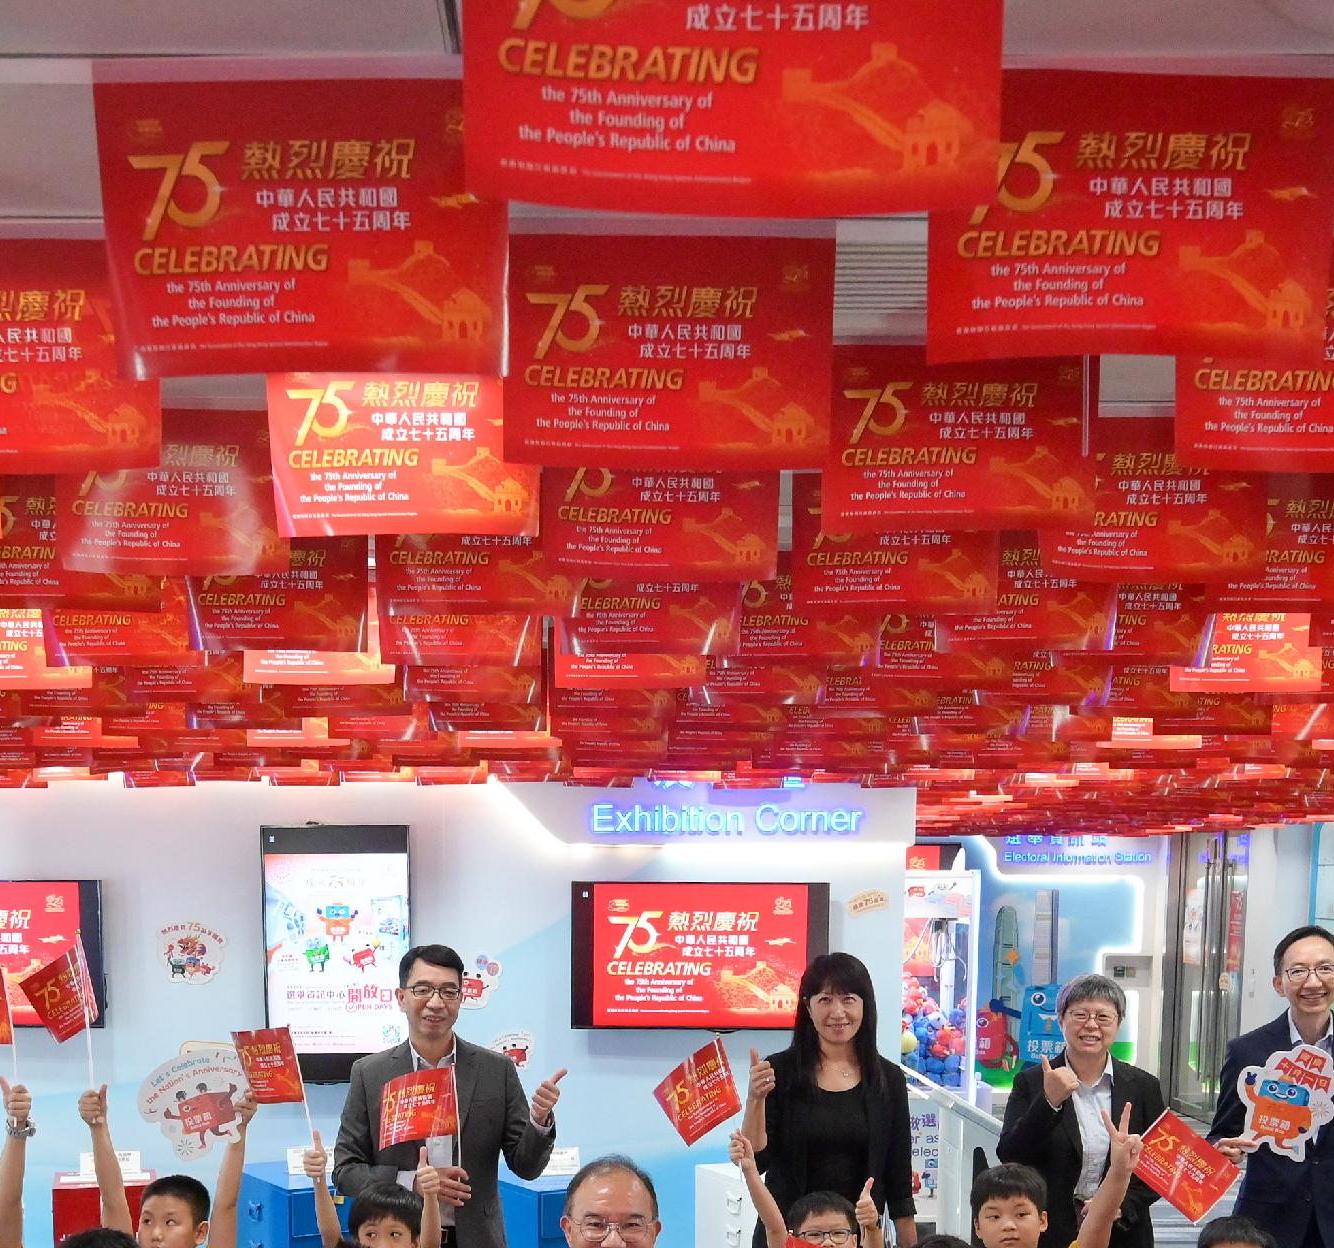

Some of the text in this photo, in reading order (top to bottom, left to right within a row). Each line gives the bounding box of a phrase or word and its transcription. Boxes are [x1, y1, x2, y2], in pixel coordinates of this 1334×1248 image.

[498, 38, 758, 83] CELEBRATING
[240, 138, 415, 181] 熱烈慶祝
[1076, 132, 1251, 171] 熱烈慶祝
[127, 141, 230, 241] 75
[255, 187, 398, 209] 中華人民共和國
[272, 210, 411, 232] 成立七十五周年
[1104, 200, 1244, 220] 成立七十五周年
[957, 230, 1160, 257] CELEBRATING
[134, 244, 328, 275] CELEBRATING
[617, 286, 758, 319] 熱烈慶祝
[526, 284, 609, 360] 75
[628, 324, 742, 340] 中華人民共和國
[640, 343, 751, 359] 成立七十五周年
[525, 365, 683, 390] CELEBRATING
[362, 381, 479, 407] 熱烈慶祝
[381, 428, 475, 441] 成立七十五周年
[288, 449, 419, 468] CELEBRATING
[592, 804, 862, 833] Exhibition Corner
[1004, 852, 1152, 863] Electoral Information Station
[668, 911, 759, 931] 熱烈慶祝
[608, 911, 664, 958] 75
[682, 947, 756, 957] 成立七十五周年
[607, 961, 712, 976] CELEBRATING
[171, 1056, 210, 1074] Celebrate
[146, 1092, 159, 1105] the
[193, 1066, 243, 1077] Anniversary
